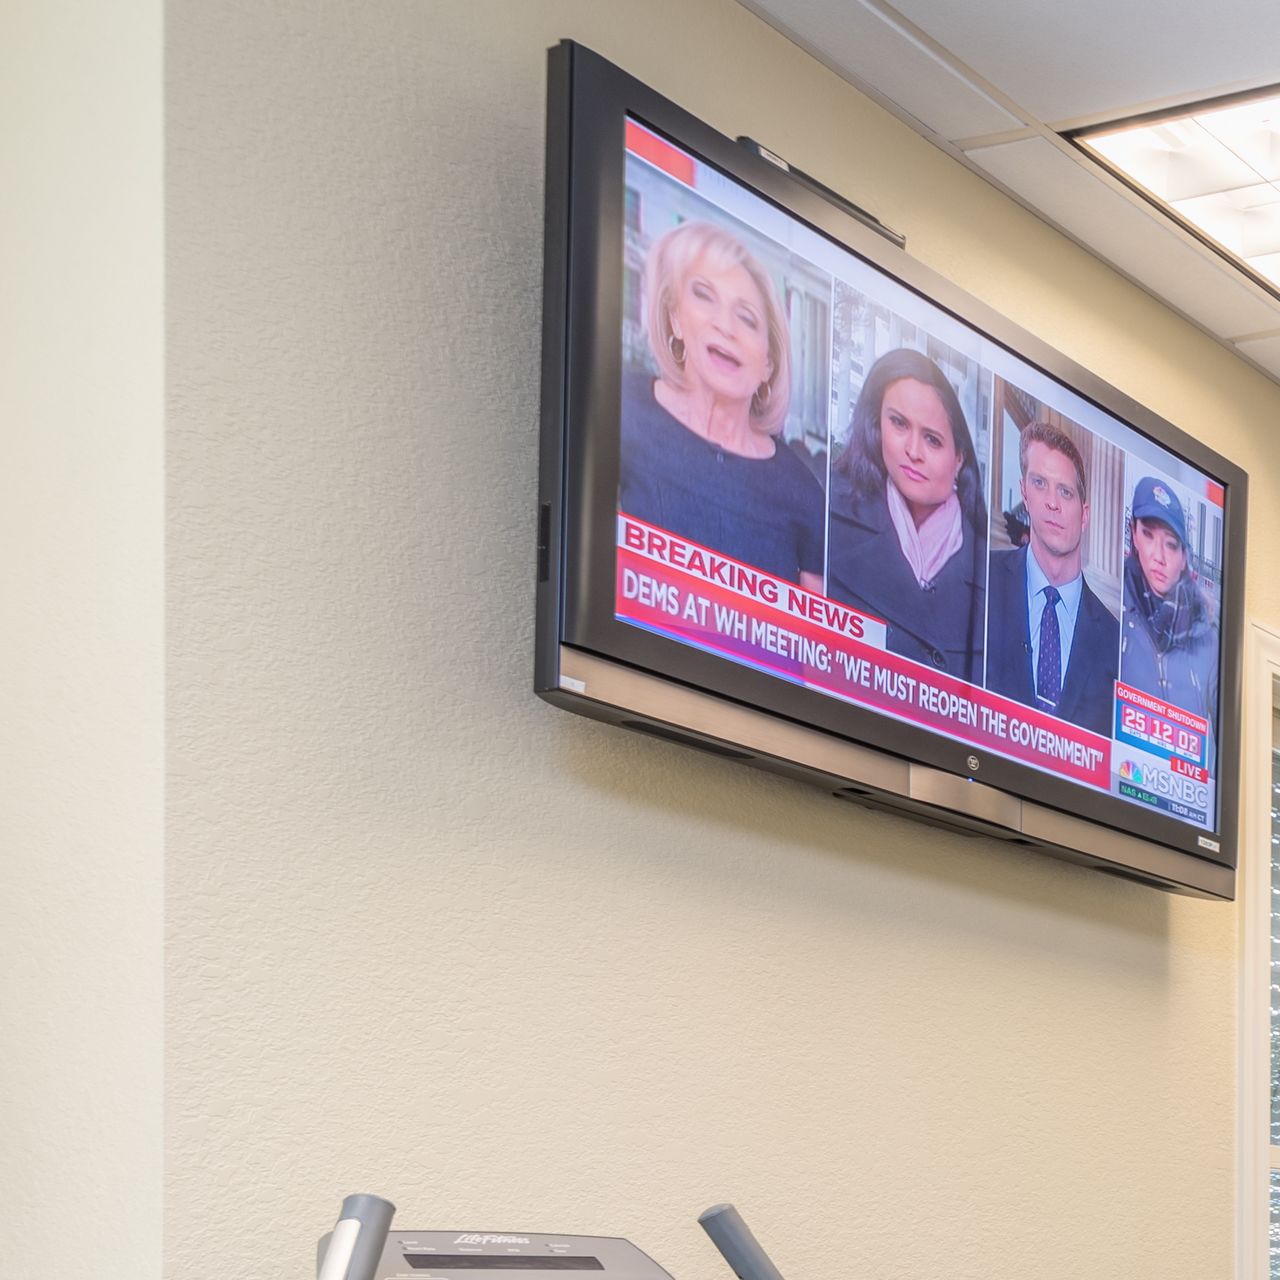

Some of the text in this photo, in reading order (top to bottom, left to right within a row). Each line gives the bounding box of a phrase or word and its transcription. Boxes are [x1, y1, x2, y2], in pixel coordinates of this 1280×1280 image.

[625, 521, 865, 638] BREAKING NEWS
[623, 567, 679, 615] DEMS
[683, 592, 710, 626] AT
[715, 604, 747, 641] WH
[751, 617, 832, 673] MEETING:
[874, 664, 917, 701] MUST
[919, 685, 978, 727] REOPEN
[980, 704, 1008, 738] THE
[1009, 717, 1104, 772] GOVERNMENT"
[1117, 686, 1207, 732] GOVERNMENT SHUTDOWN
[1125, 708, 1146, 732] 25
[1153, 719, 1173, 743] 12
[1142, 764, 1208, 808] MSNBC
[1177, 758, 1202, 779] LIVE
